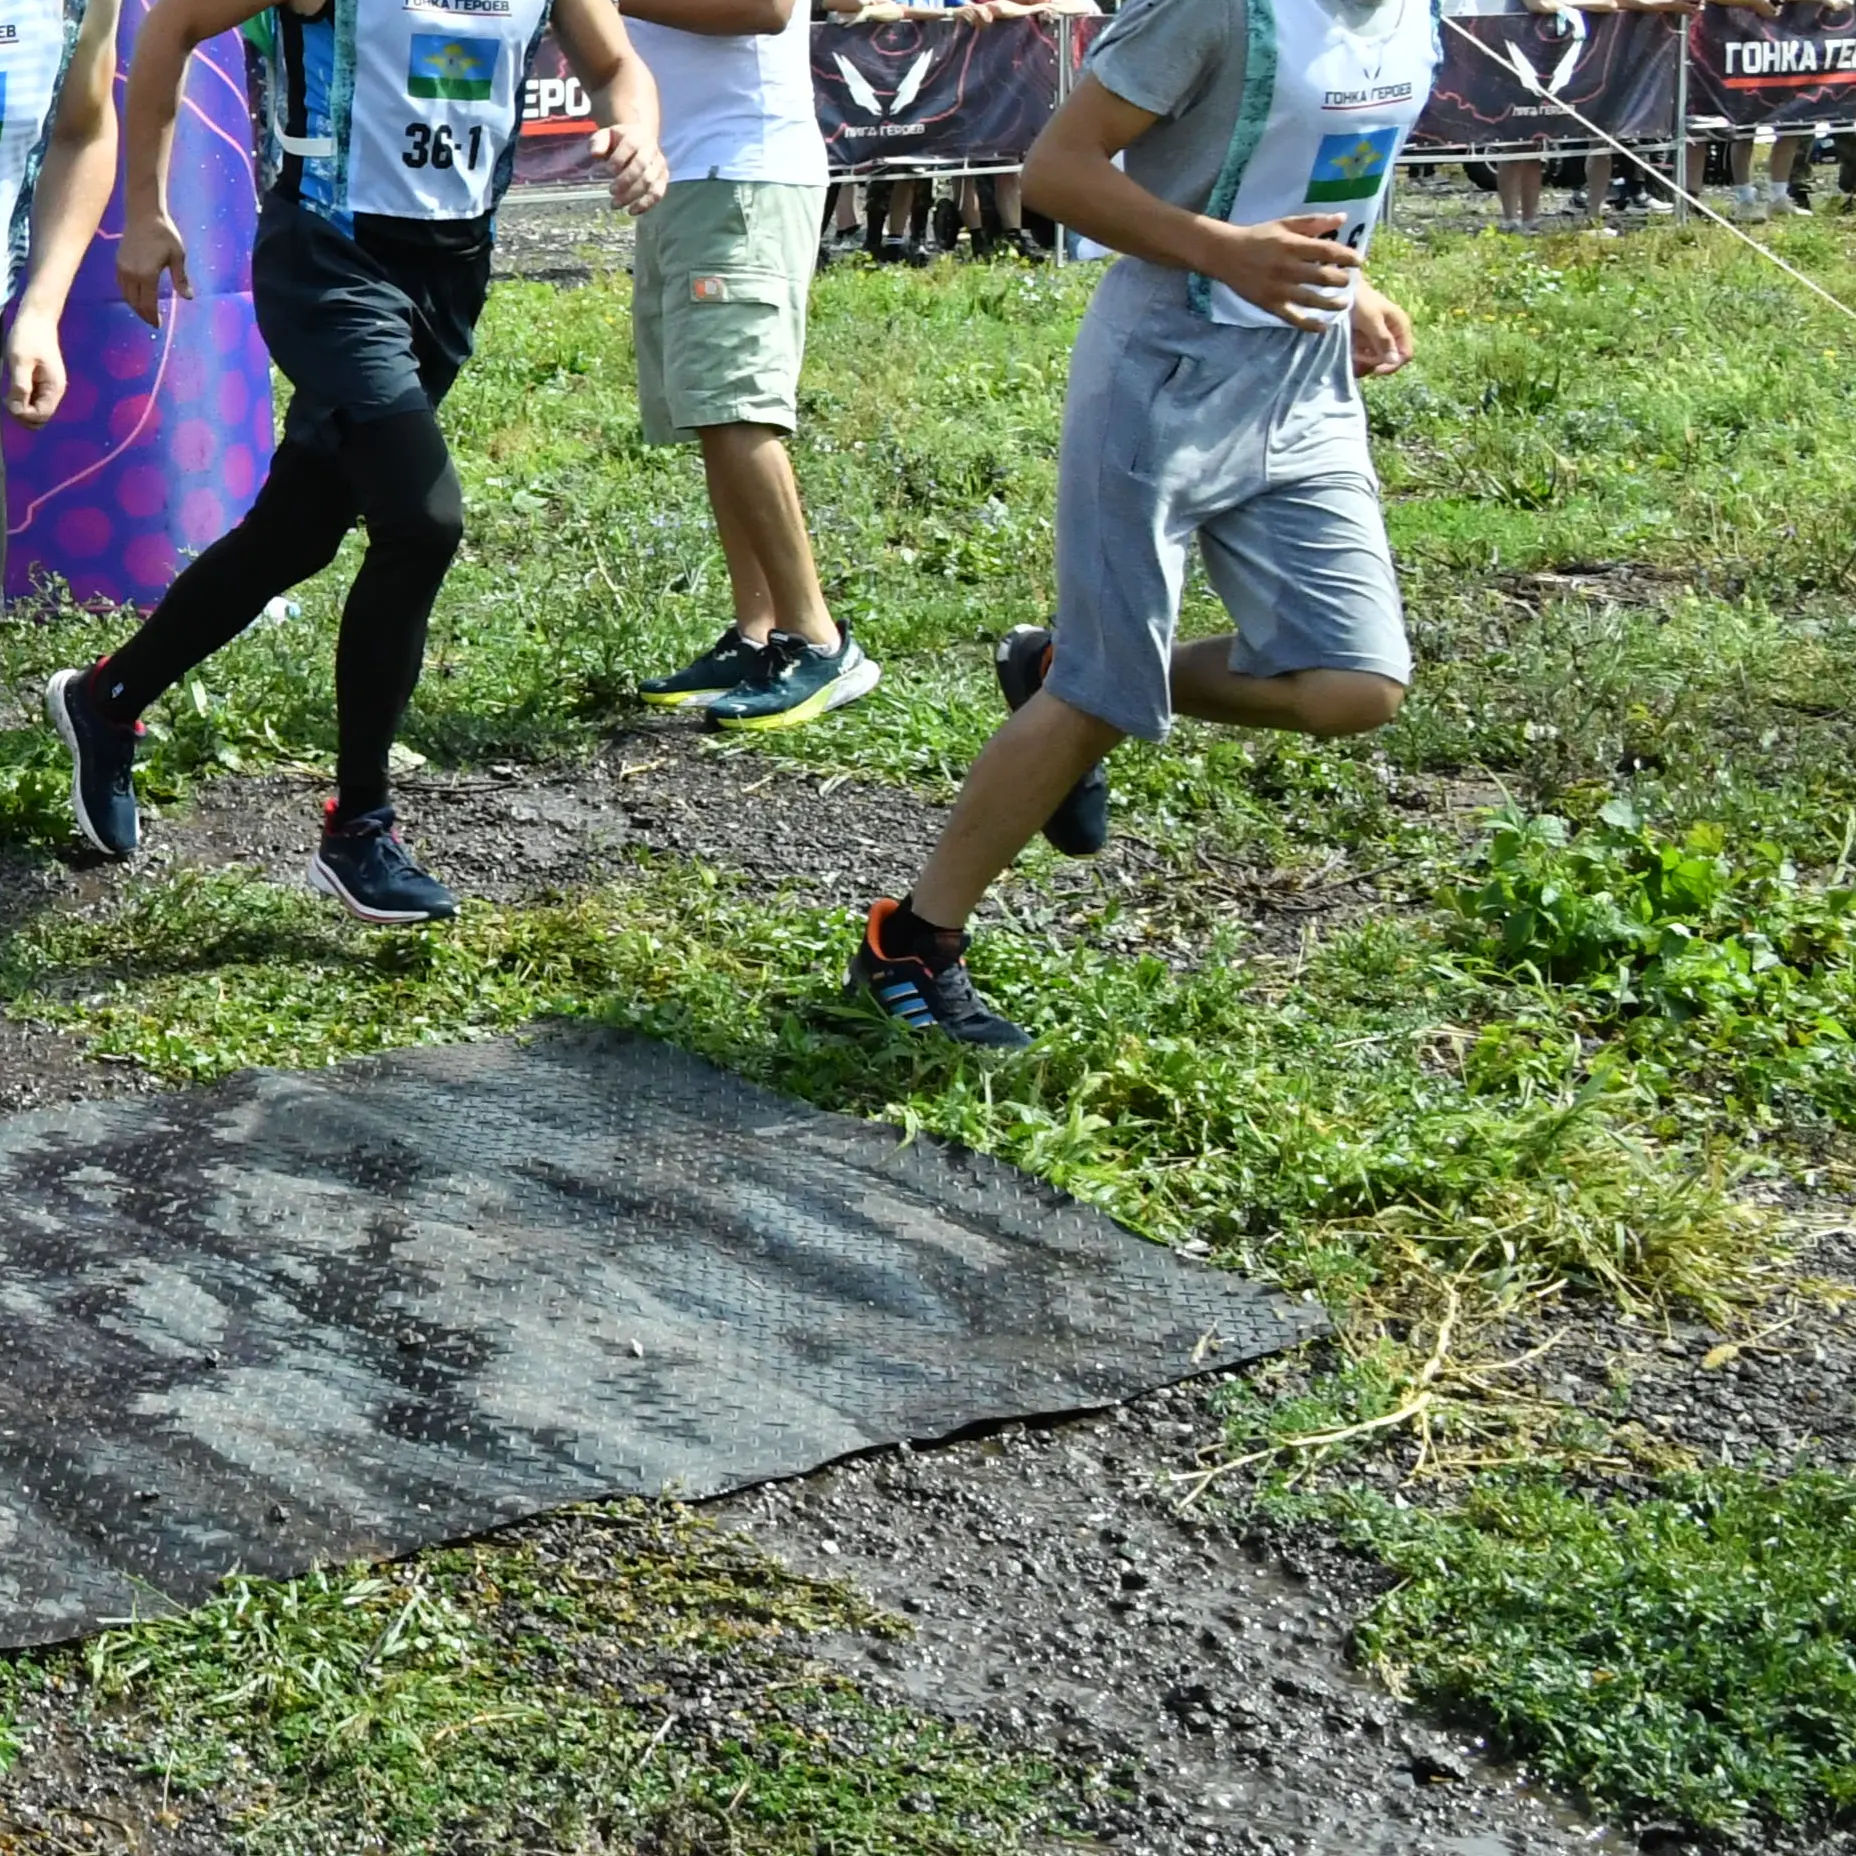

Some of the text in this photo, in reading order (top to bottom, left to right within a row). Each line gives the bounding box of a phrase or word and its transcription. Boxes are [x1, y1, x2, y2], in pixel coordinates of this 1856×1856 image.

[1725, 39, 1818, 74] ГОНКА
[1324, 81, 1412, 105] ГОНКА ГЕРОЕВ
[402, 122, 483, 171] 36-1
